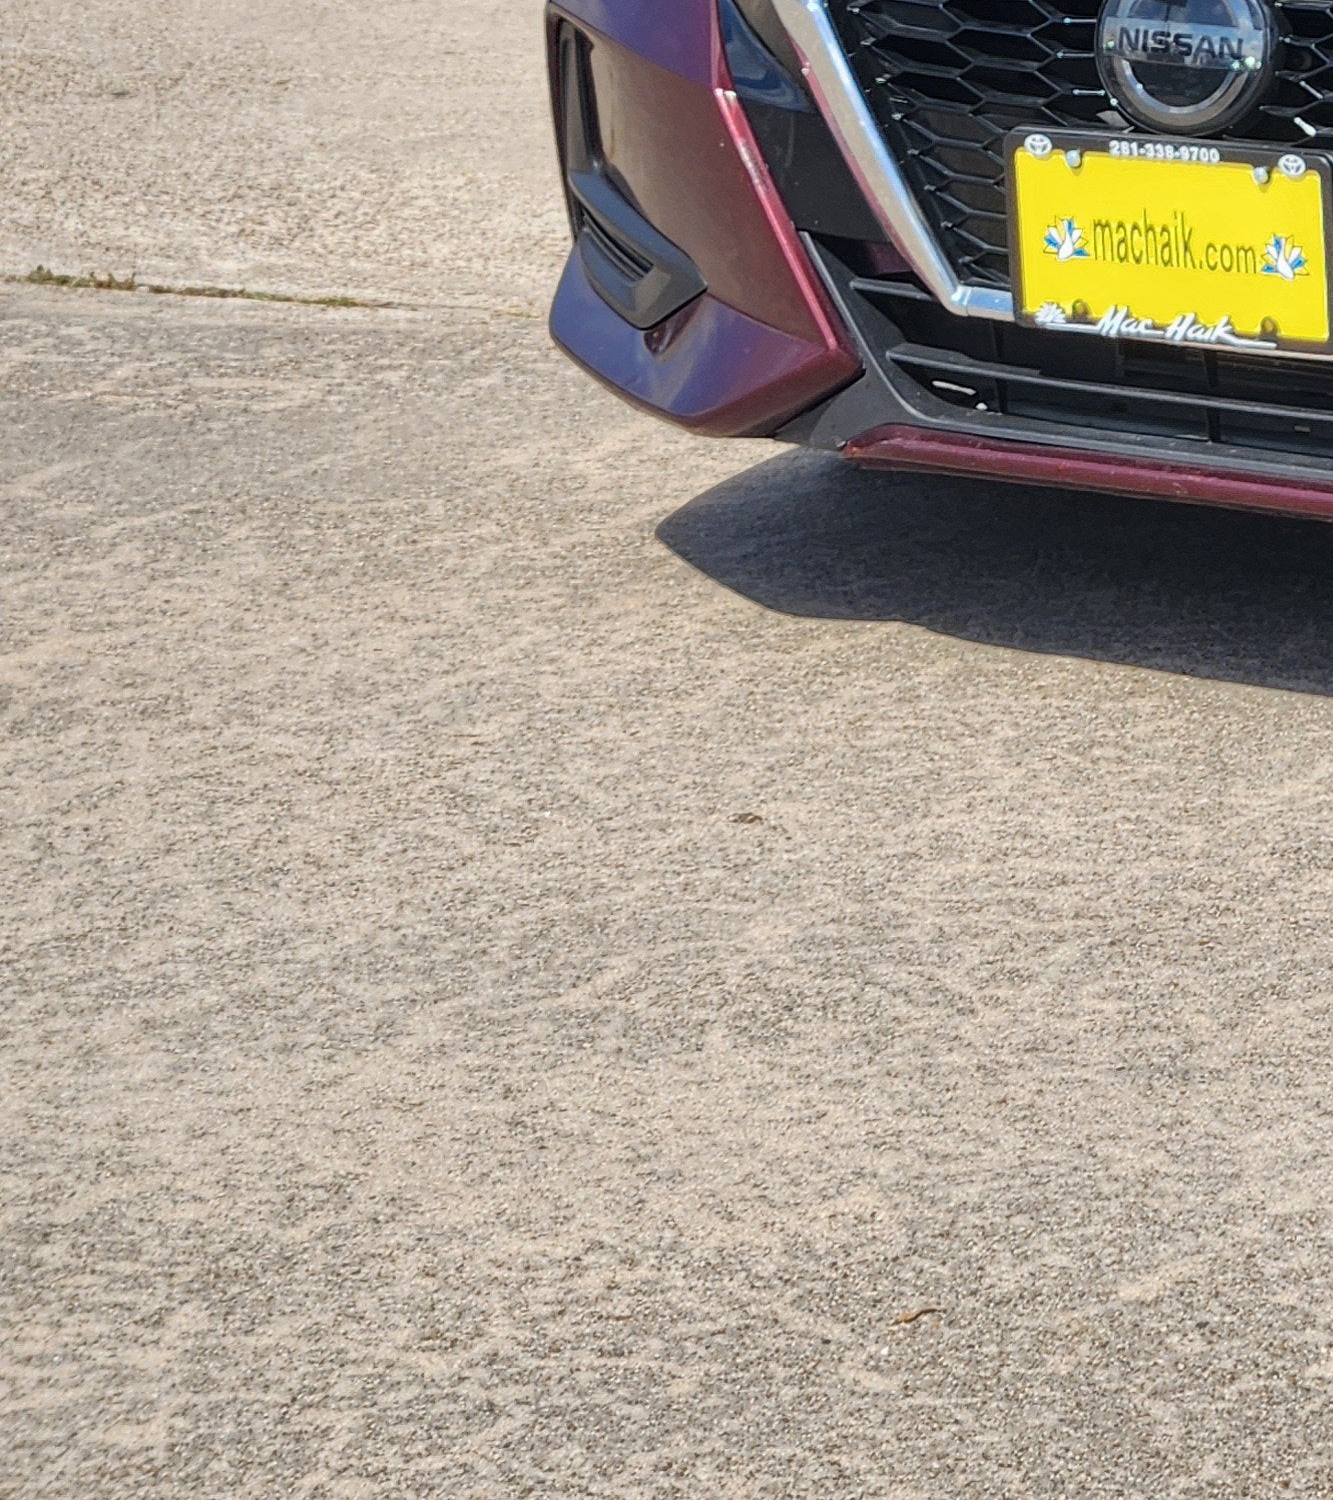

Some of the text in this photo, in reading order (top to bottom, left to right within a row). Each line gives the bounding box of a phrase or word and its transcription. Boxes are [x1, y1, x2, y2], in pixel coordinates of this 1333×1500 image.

[1117, 26, 1245, 60] NISSAN
[1108, 139, 1221, 164] 281-338-9700
[1091, 207, 1259, 276] machaik.com
[1094, 304, 1240, 344] Mac Haik
